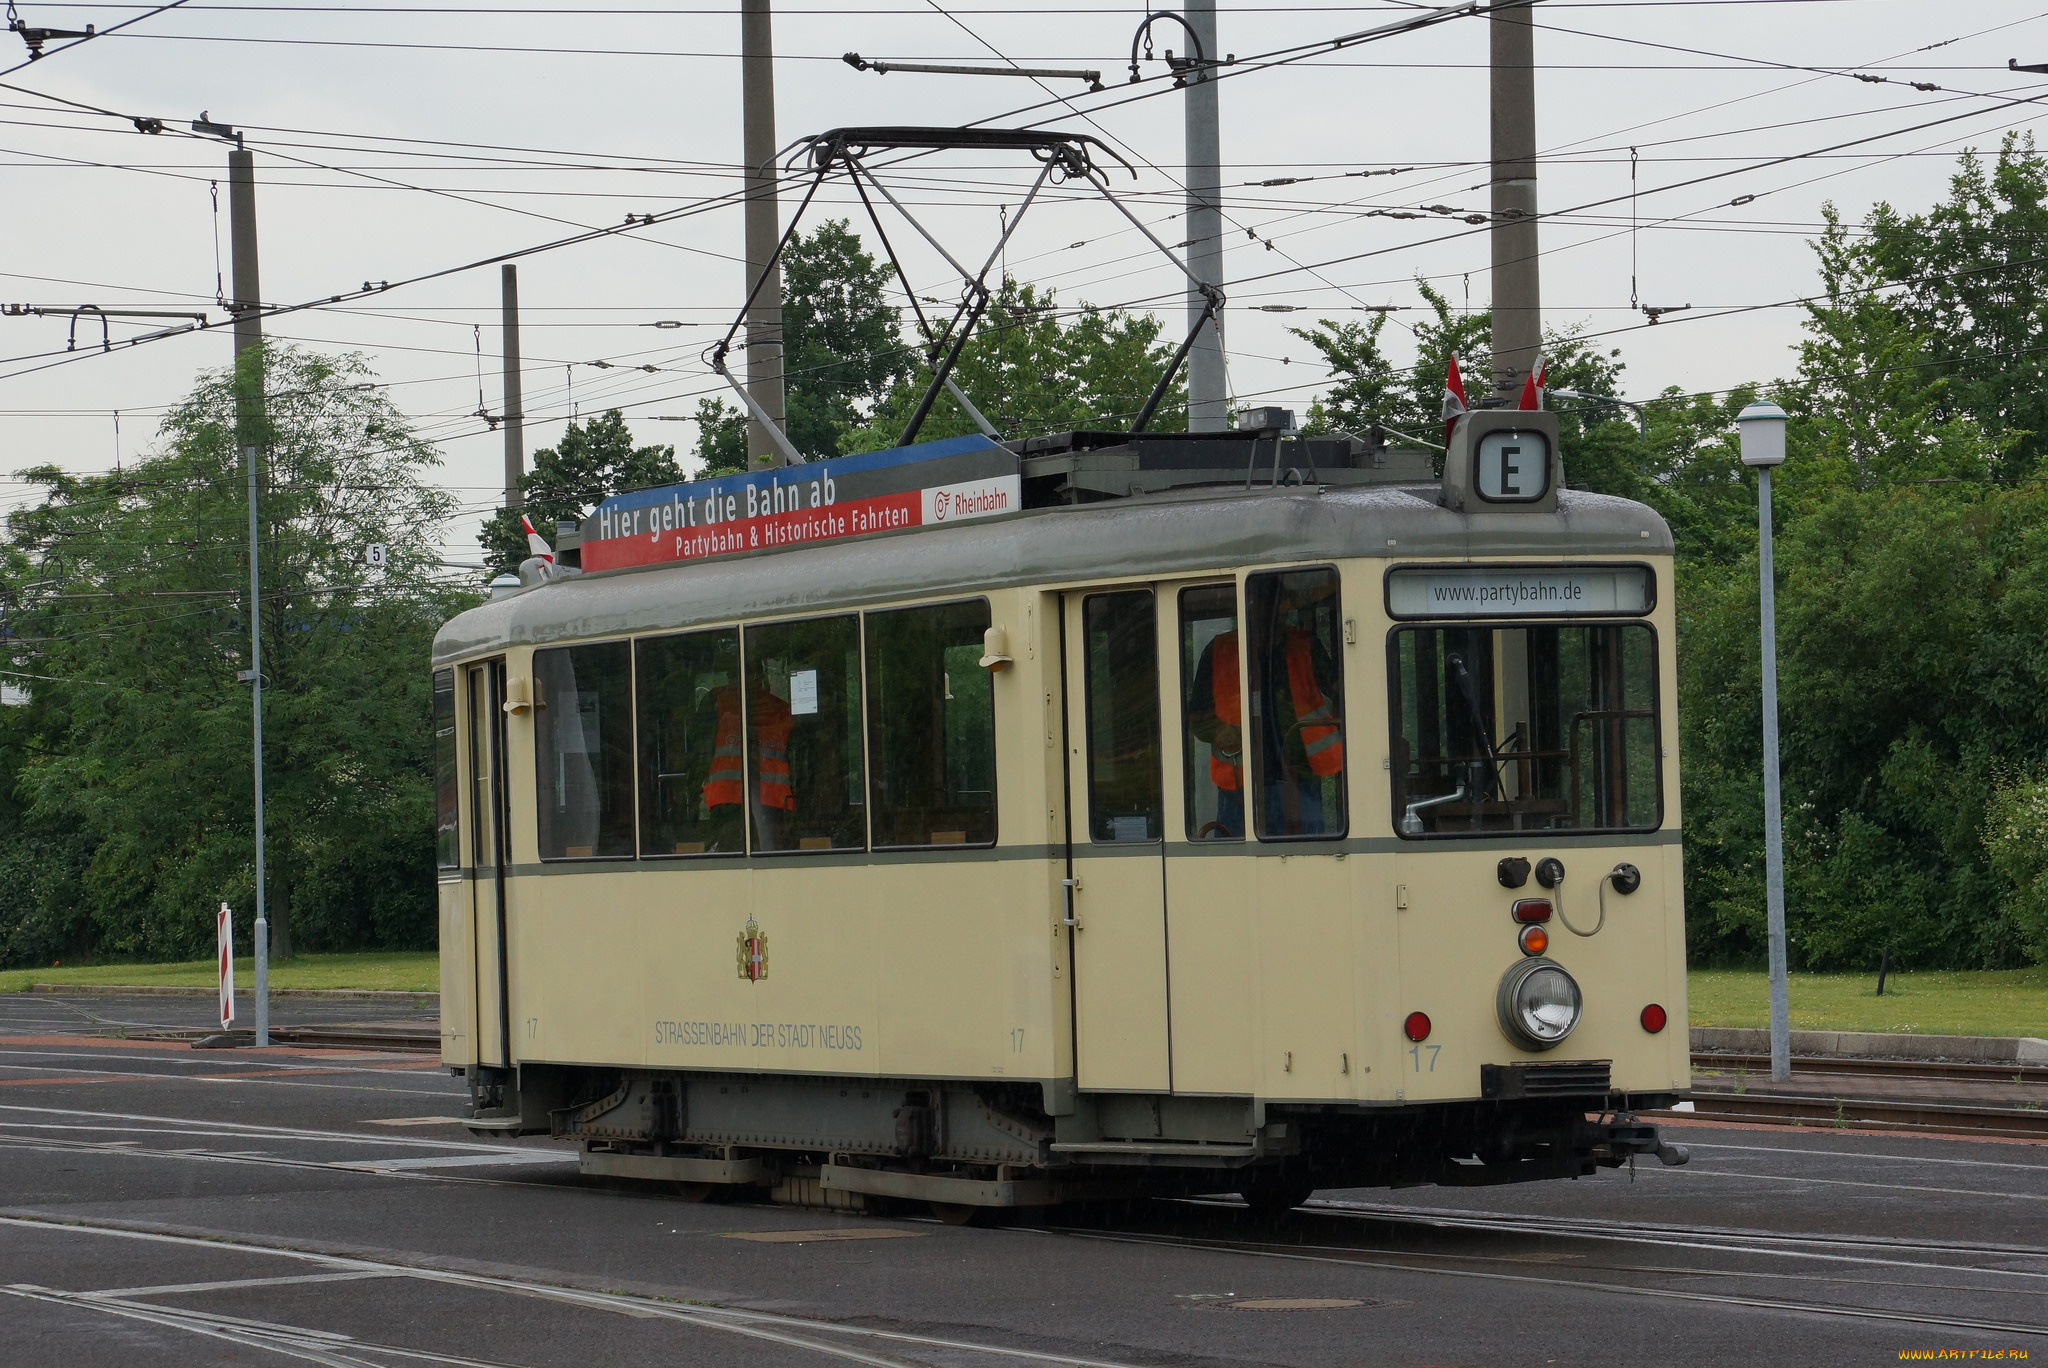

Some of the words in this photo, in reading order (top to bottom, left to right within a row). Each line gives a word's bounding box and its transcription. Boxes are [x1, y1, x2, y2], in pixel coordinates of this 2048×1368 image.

[1500, 446, 1521, 495] E
[600, 503, 641, 541] Hier
[650, 493, 696, 543] geht
[705, 486, 737, 525] die
[746, 477, 799, 519] Bahn
[810, 468, 836, 509] ab
[955, 487, 1007, 516] Rheinbahn
[676, 528, 744, 558] Partybahn
[750, 525, 759, 548] &
[765, 512, 845, 545] Historische
[852, 505, 909, 532] Fahrten
[372, 546, 381, 562] 5
[1434, 580, 1582, 606] www.partybahn.de
[526, 1017, 538, 1040] 17
[655, 1020, 747, 1047] STRASSENBAHN
[751, 1023, 775, 1048] DER
[778, 1023, 816, 1049] STADT
[819, 1024, 863, 1051] NEUSS
[1010, 1027, 1025, 1054] 17
[1408, 1044, 1442, 1073] 17
